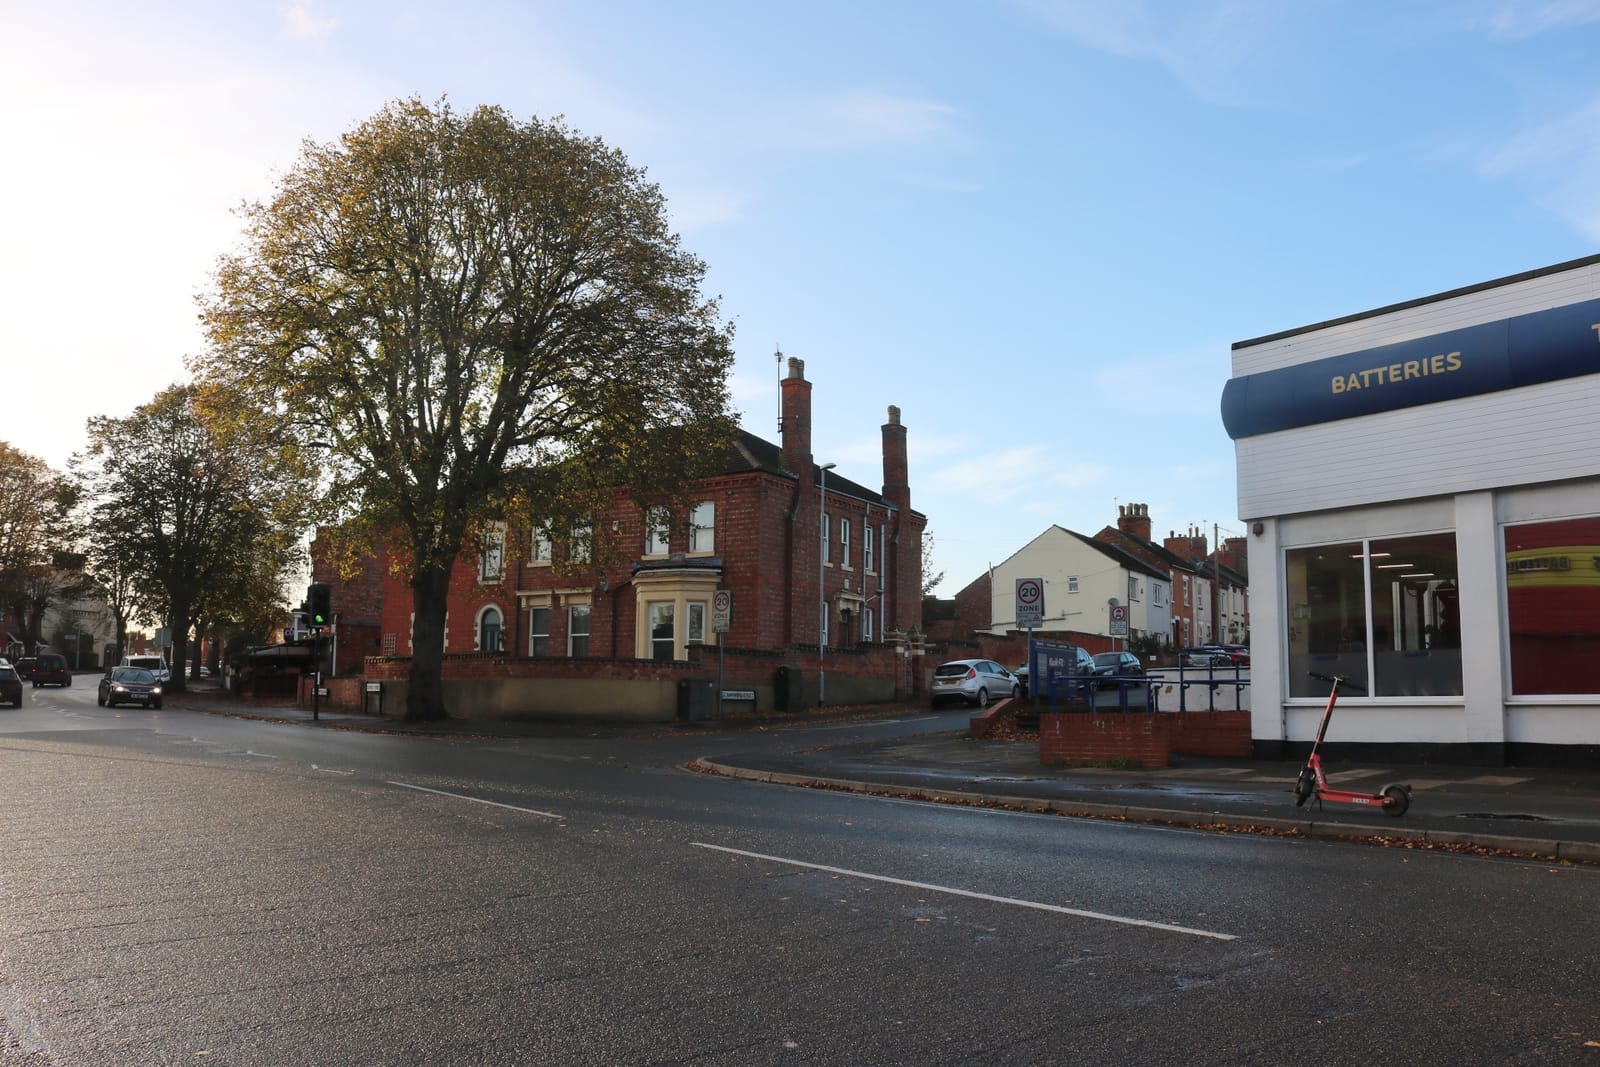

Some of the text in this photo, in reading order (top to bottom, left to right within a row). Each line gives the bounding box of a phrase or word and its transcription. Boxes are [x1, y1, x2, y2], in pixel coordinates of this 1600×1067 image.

[1331, 351, 1462, 394] BATTERIES
[1022, 587, 1037, 597] 20
[717, 598, 727, 606] 20
